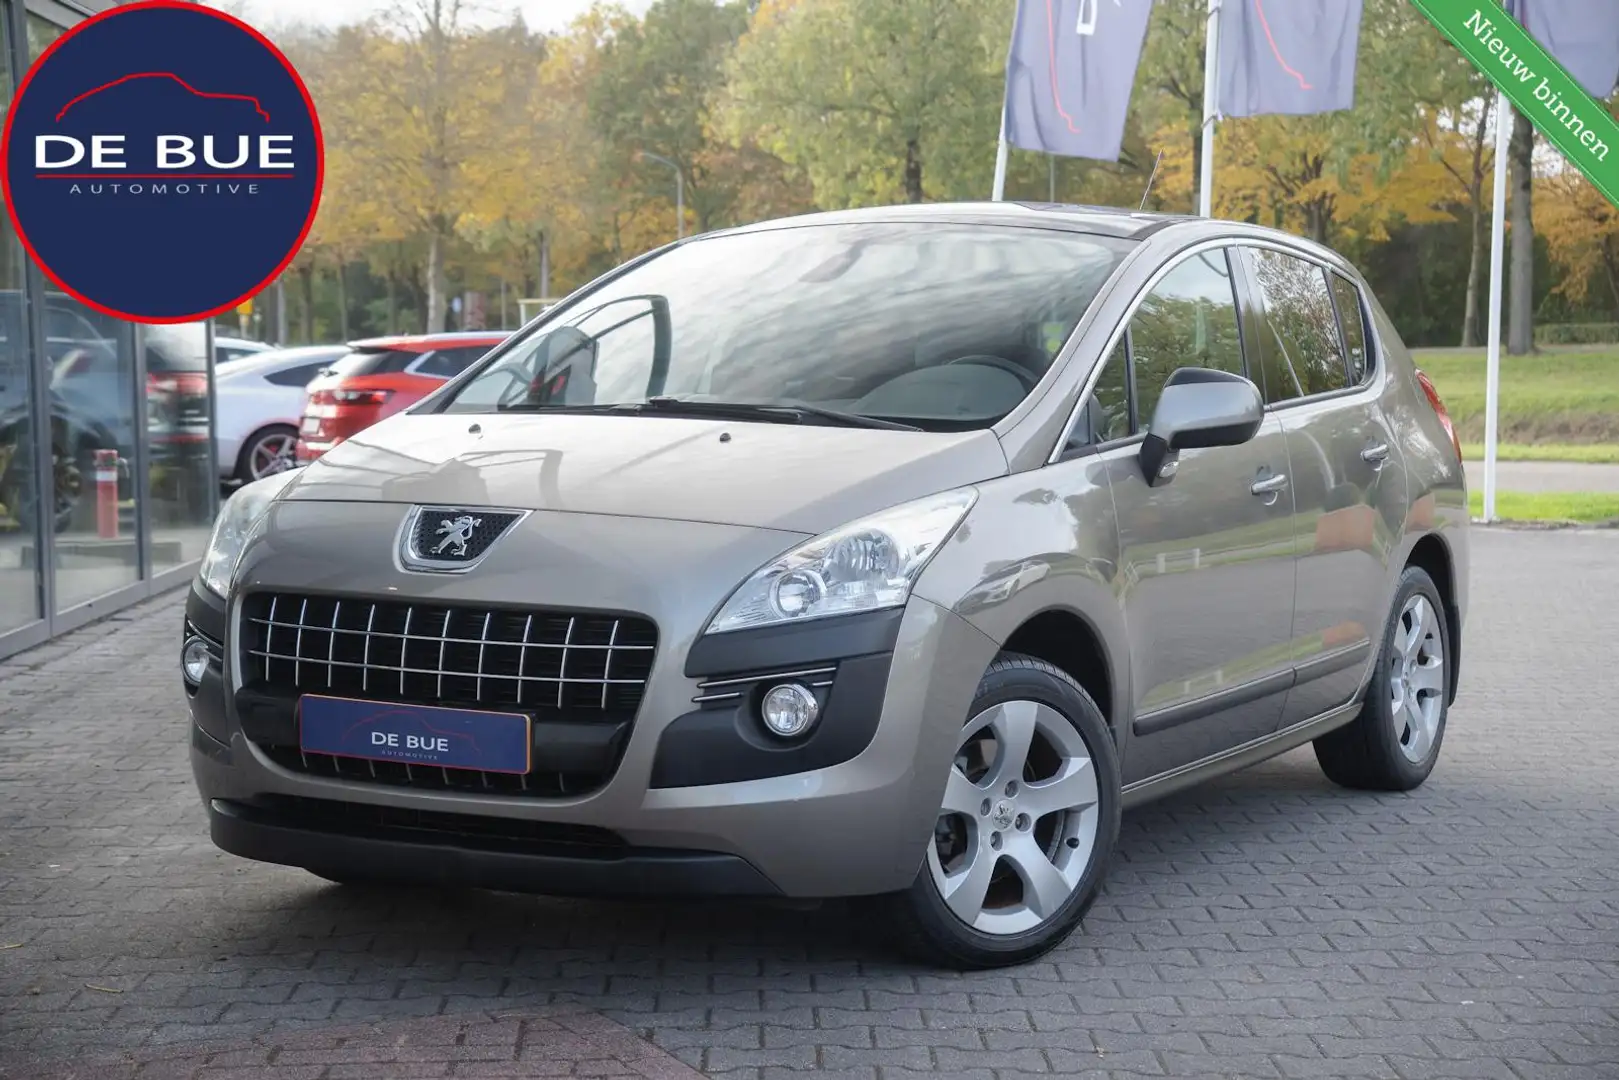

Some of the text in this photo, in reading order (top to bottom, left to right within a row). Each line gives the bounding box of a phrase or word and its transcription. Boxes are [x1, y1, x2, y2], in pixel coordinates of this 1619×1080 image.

[371, 731, 449, 752] DE BUE
[381, 750, 438, 760] AUTOMOTIVE
